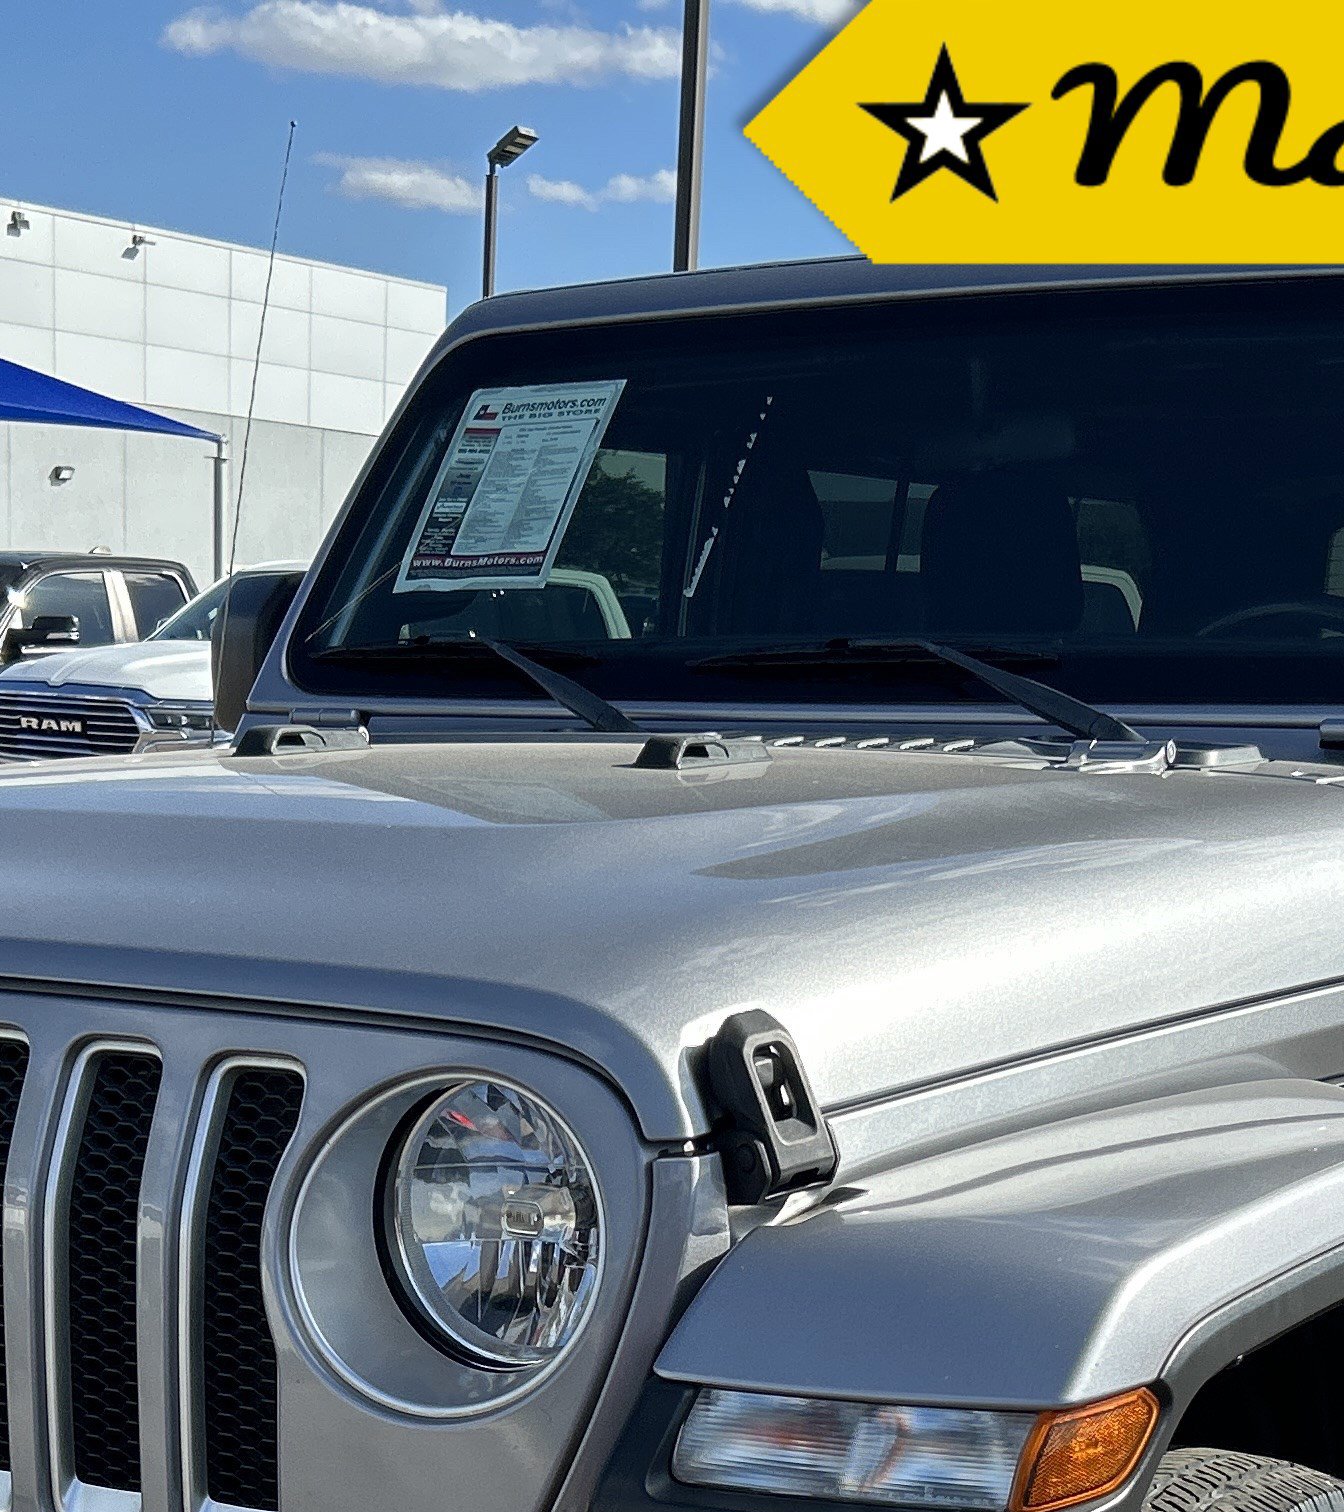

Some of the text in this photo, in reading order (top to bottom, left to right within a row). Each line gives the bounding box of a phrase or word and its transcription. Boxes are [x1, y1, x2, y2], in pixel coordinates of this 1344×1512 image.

[502, 398, 607, 415] Burnsmotors.com
[502, 408, 602, 422] THE BIG STORE
[20, 716, 82, 733] RAM
